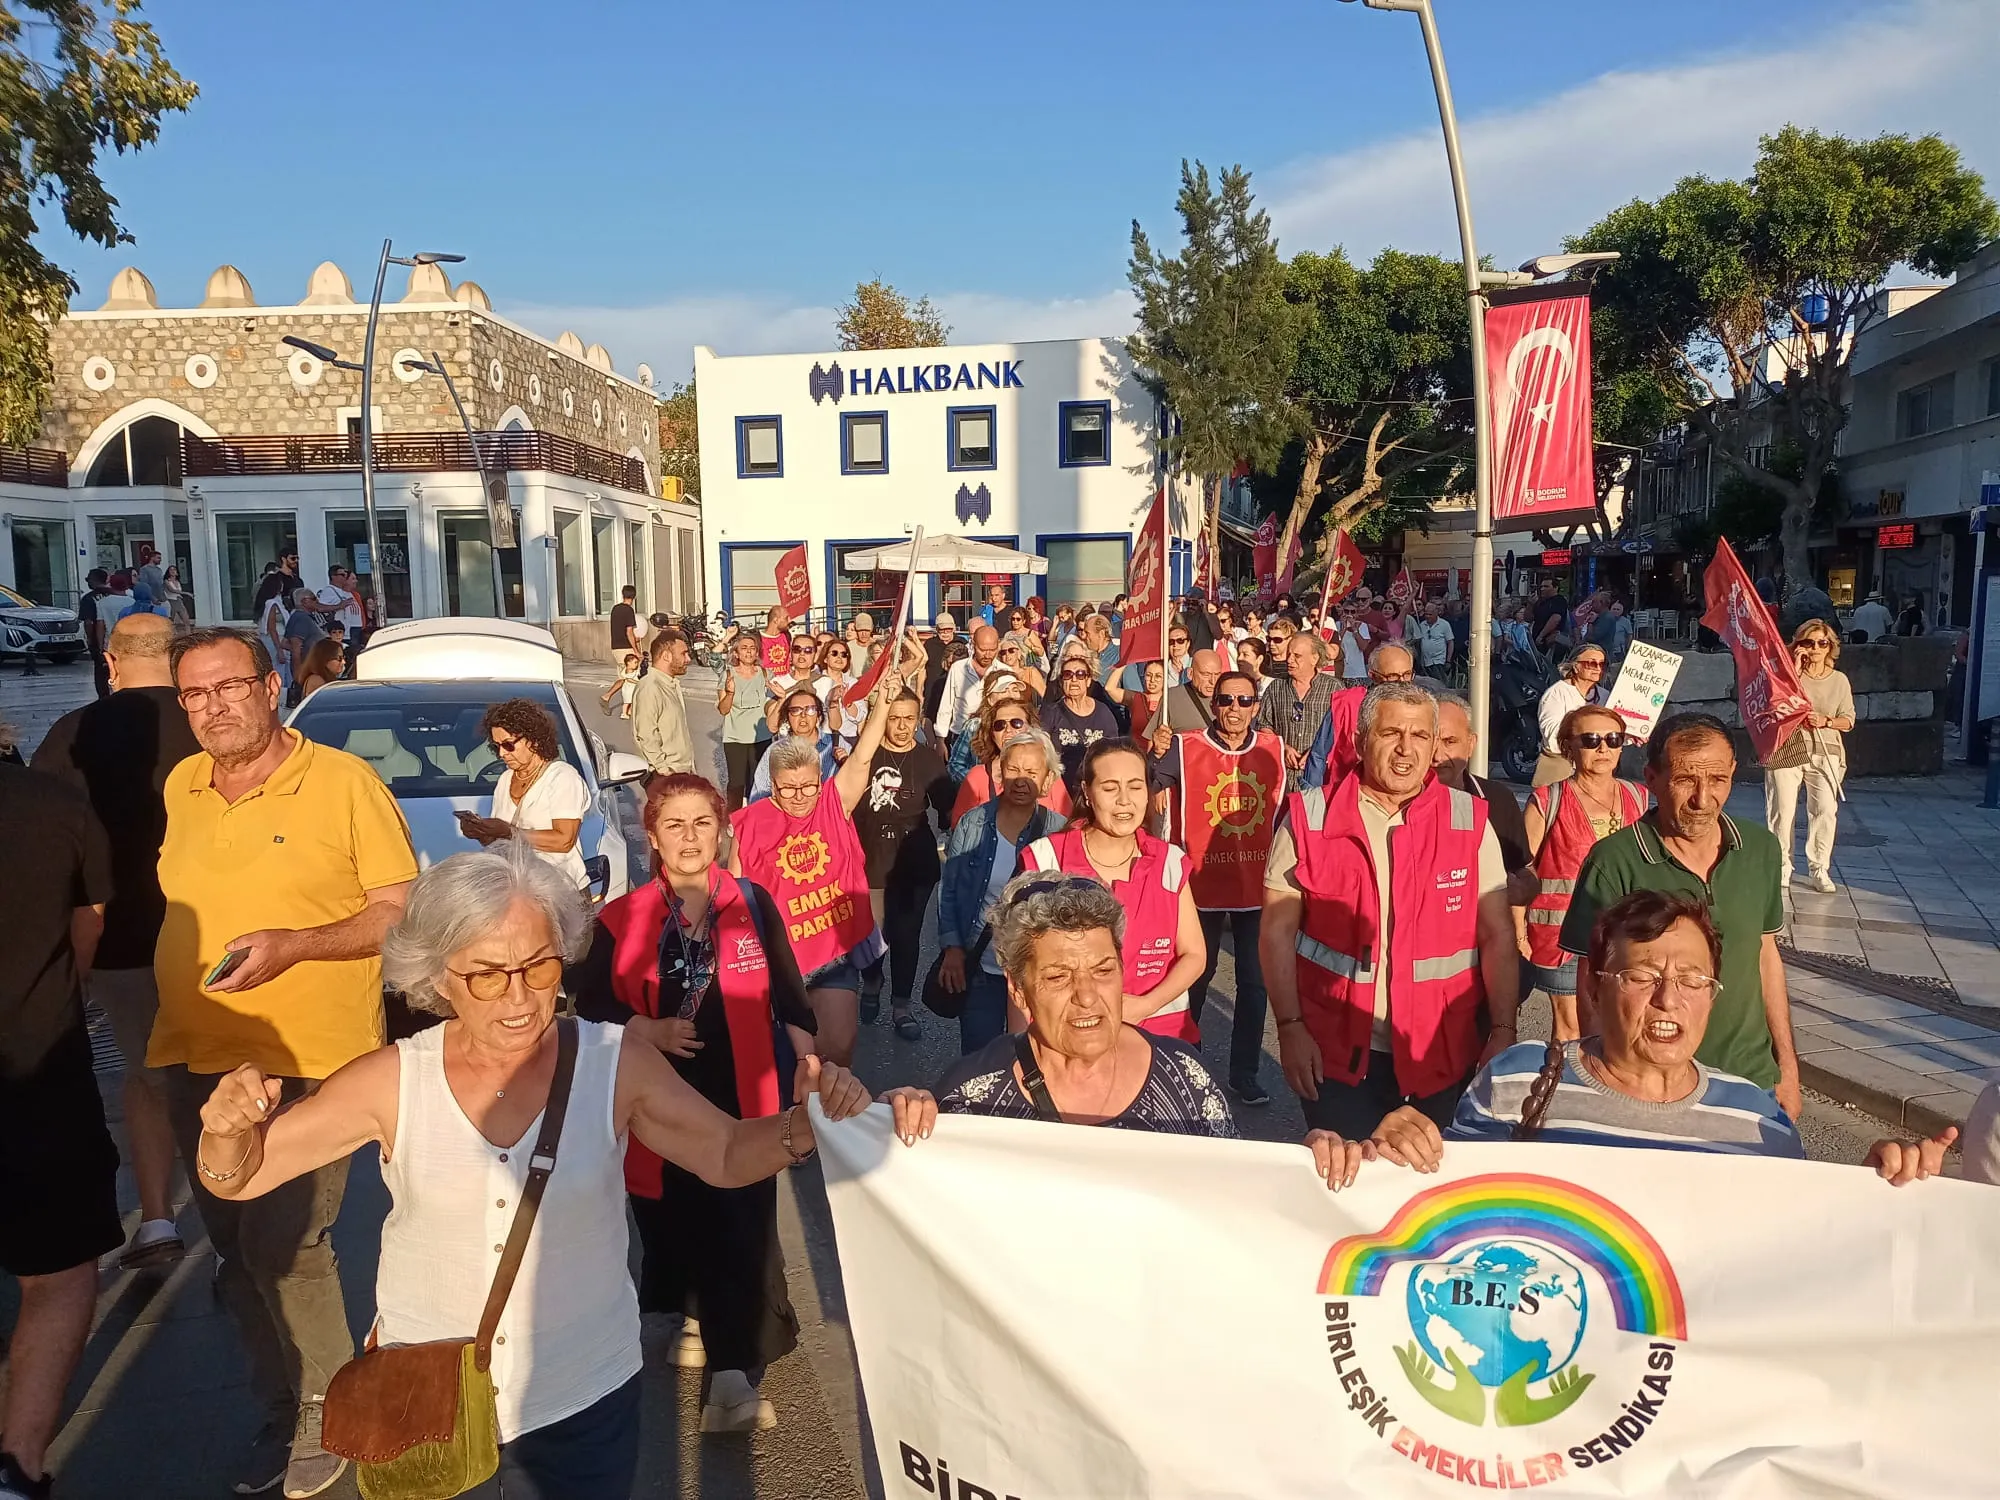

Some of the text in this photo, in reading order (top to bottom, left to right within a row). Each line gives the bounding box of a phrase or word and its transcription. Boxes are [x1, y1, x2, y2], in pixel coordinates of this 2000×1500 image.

[849, 359, 1024, 396] HALKBANK
[1537, 488, 1567, 496] BODRUM
[1630, 643, 1680, 668] KAZANACAK
[1622, 665, 1669, 687] MEMLEKET
[1219, 796, 1257, 812] EMEP
[789, 843, 818, 866] EMEP
[1204, 850, 1234, 864] EMEK
[788, 879, 844, 917] EMEK
[789, 895, 855, 943] PARTİSİ
[1154, 938, 1171, 948] CHP
[1450, 1278, 1541, 1315] B.E.S
[1324, 1301, 1398, 1438] BİRLEŞİK
[1567, 1342, 1676, 1469] SENDİKASI
[1391, 1425, 1568, 1490] EMEKLİLER
